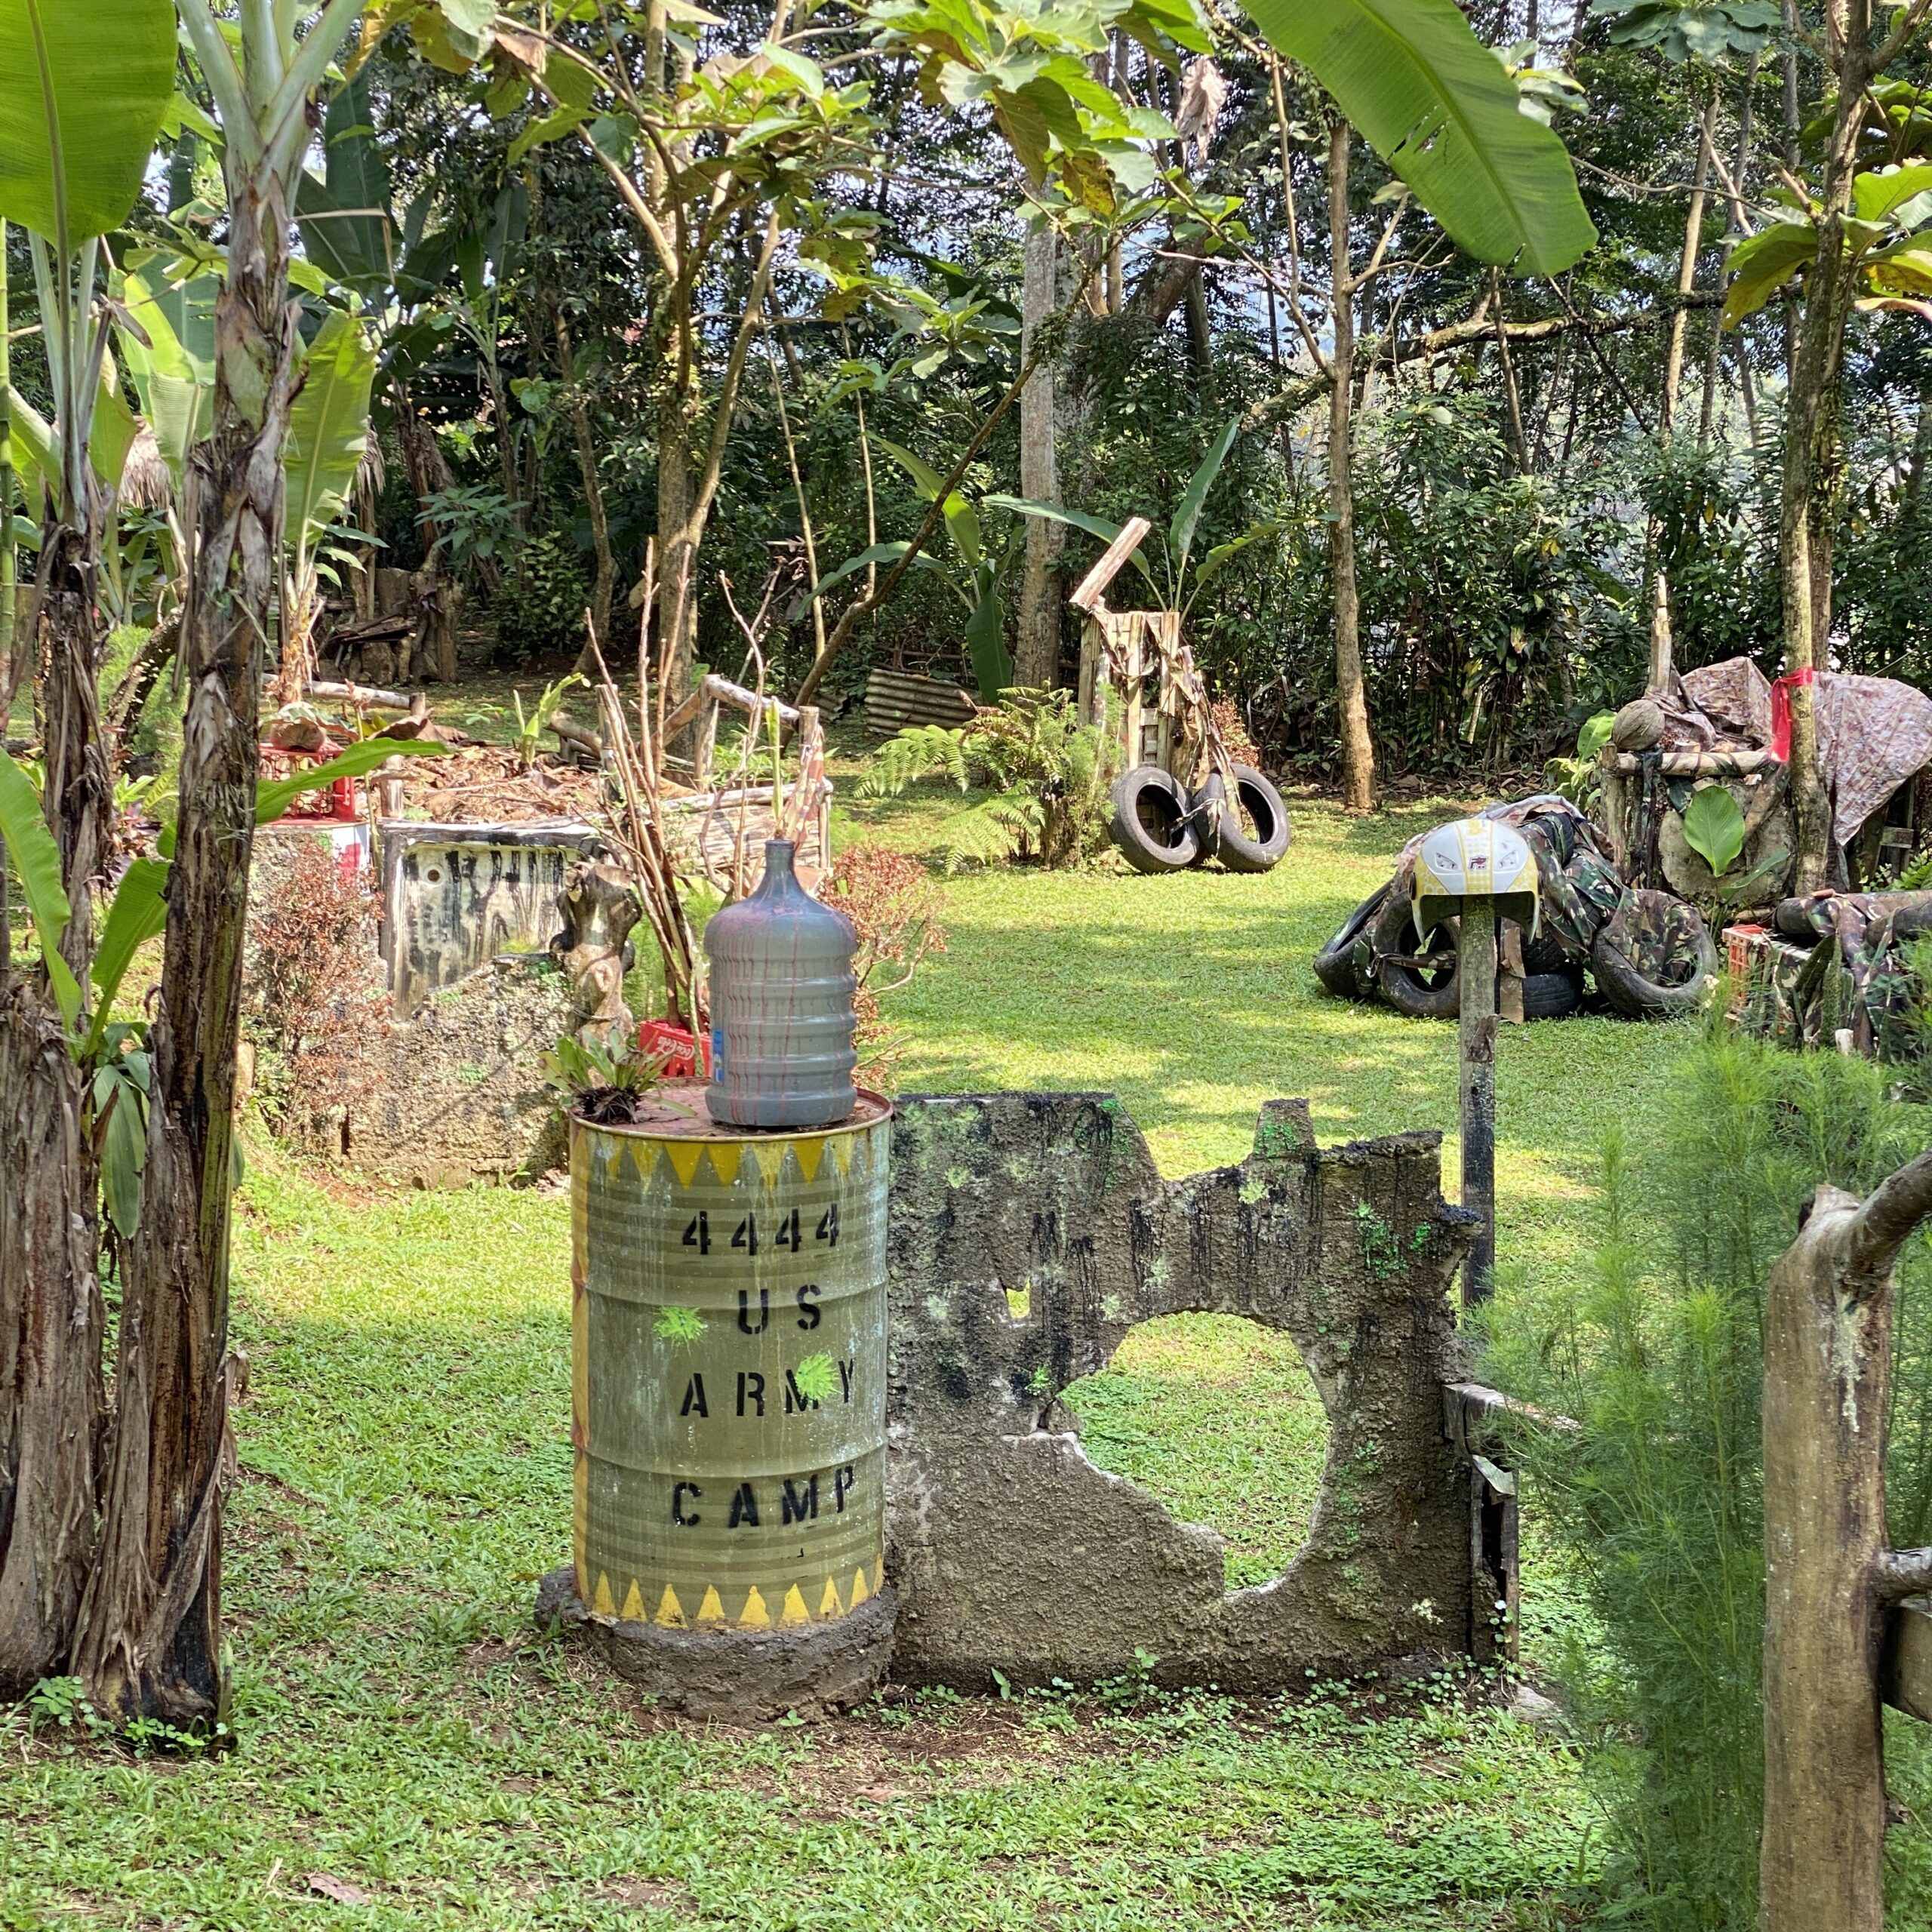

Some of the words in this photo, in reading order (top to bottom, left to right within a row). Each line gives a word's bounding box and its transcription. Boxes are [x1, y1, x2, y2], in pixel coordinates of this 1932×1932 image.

[682, 1203, 838, 1255] 4444
[737, 1284, 822, 1334] US
[672, 1466, 854, 1528] CAMP
